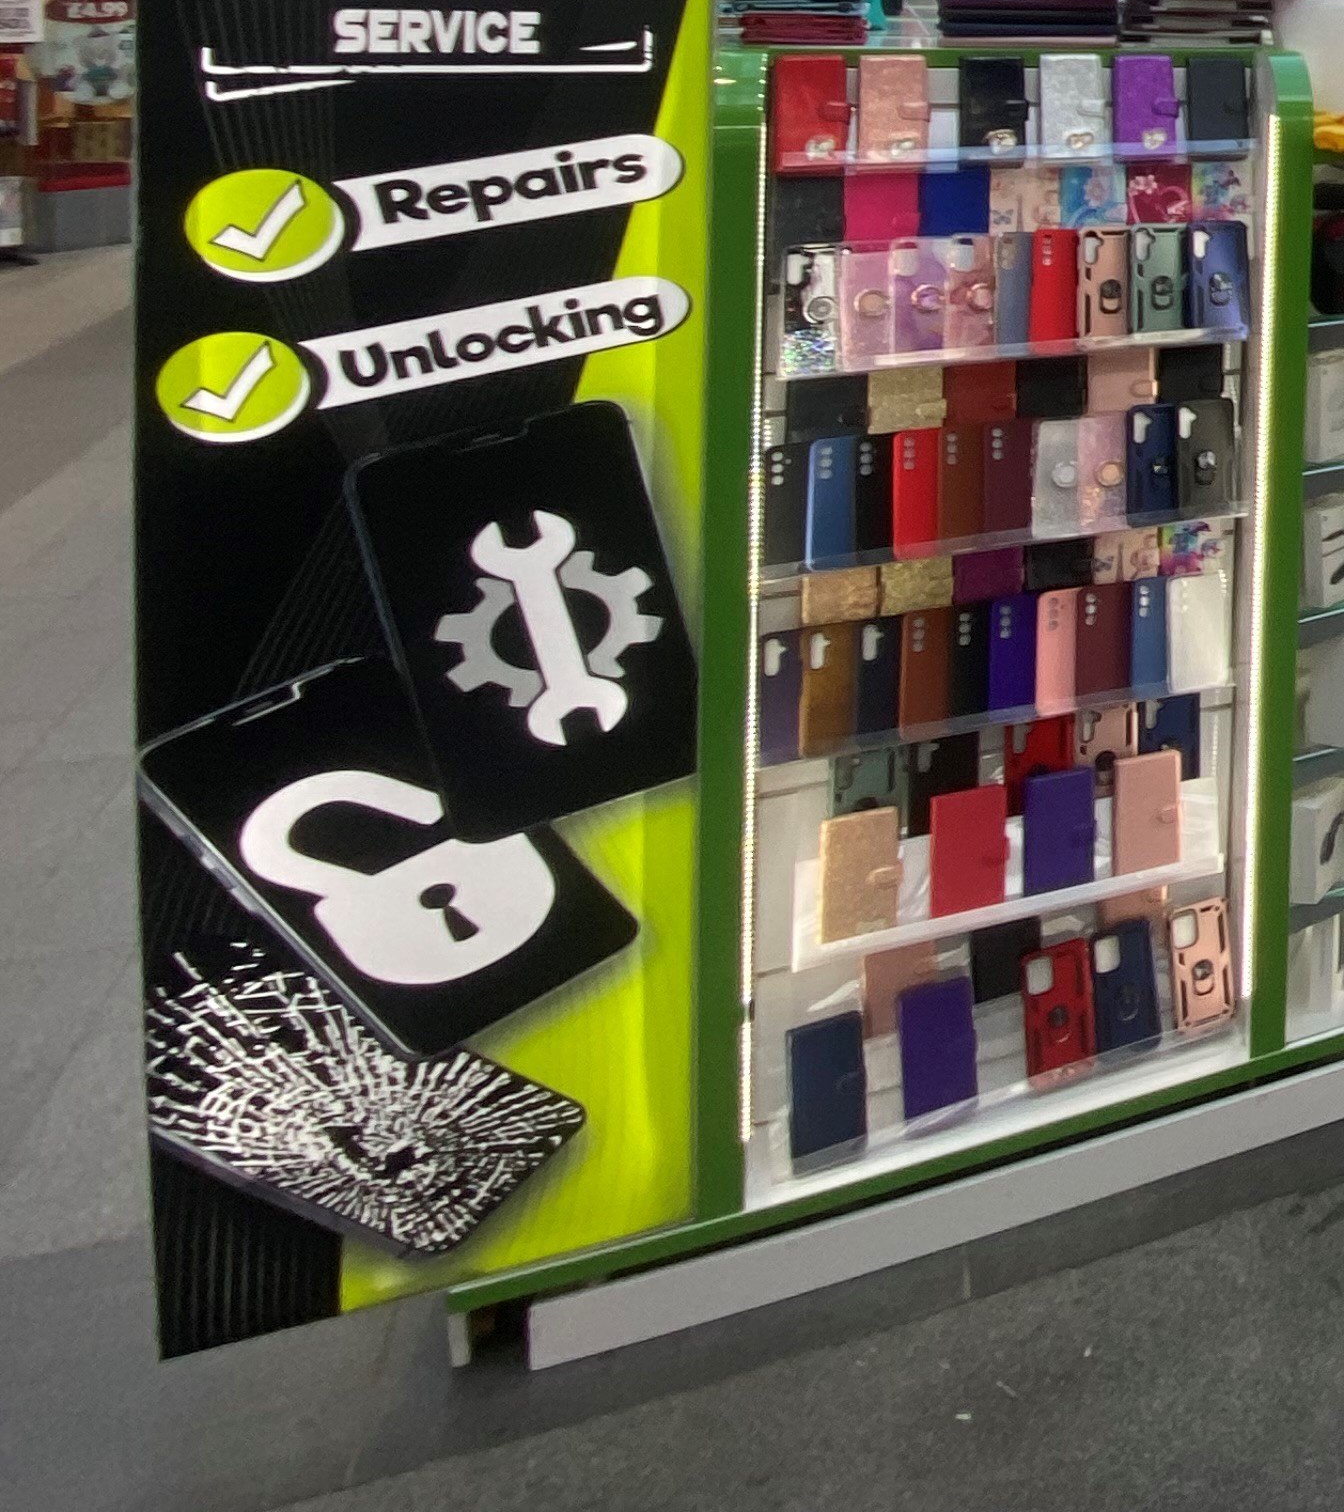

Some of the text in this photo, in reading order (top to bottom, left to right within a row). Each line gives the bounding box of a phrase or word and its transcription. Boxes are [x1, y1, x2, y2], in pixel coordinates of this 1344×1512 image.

[333, 9, 541, 55] SERVICE
[374, 149, 648, 227] Repairs
[339, 291, 665, 388] Unlocking
